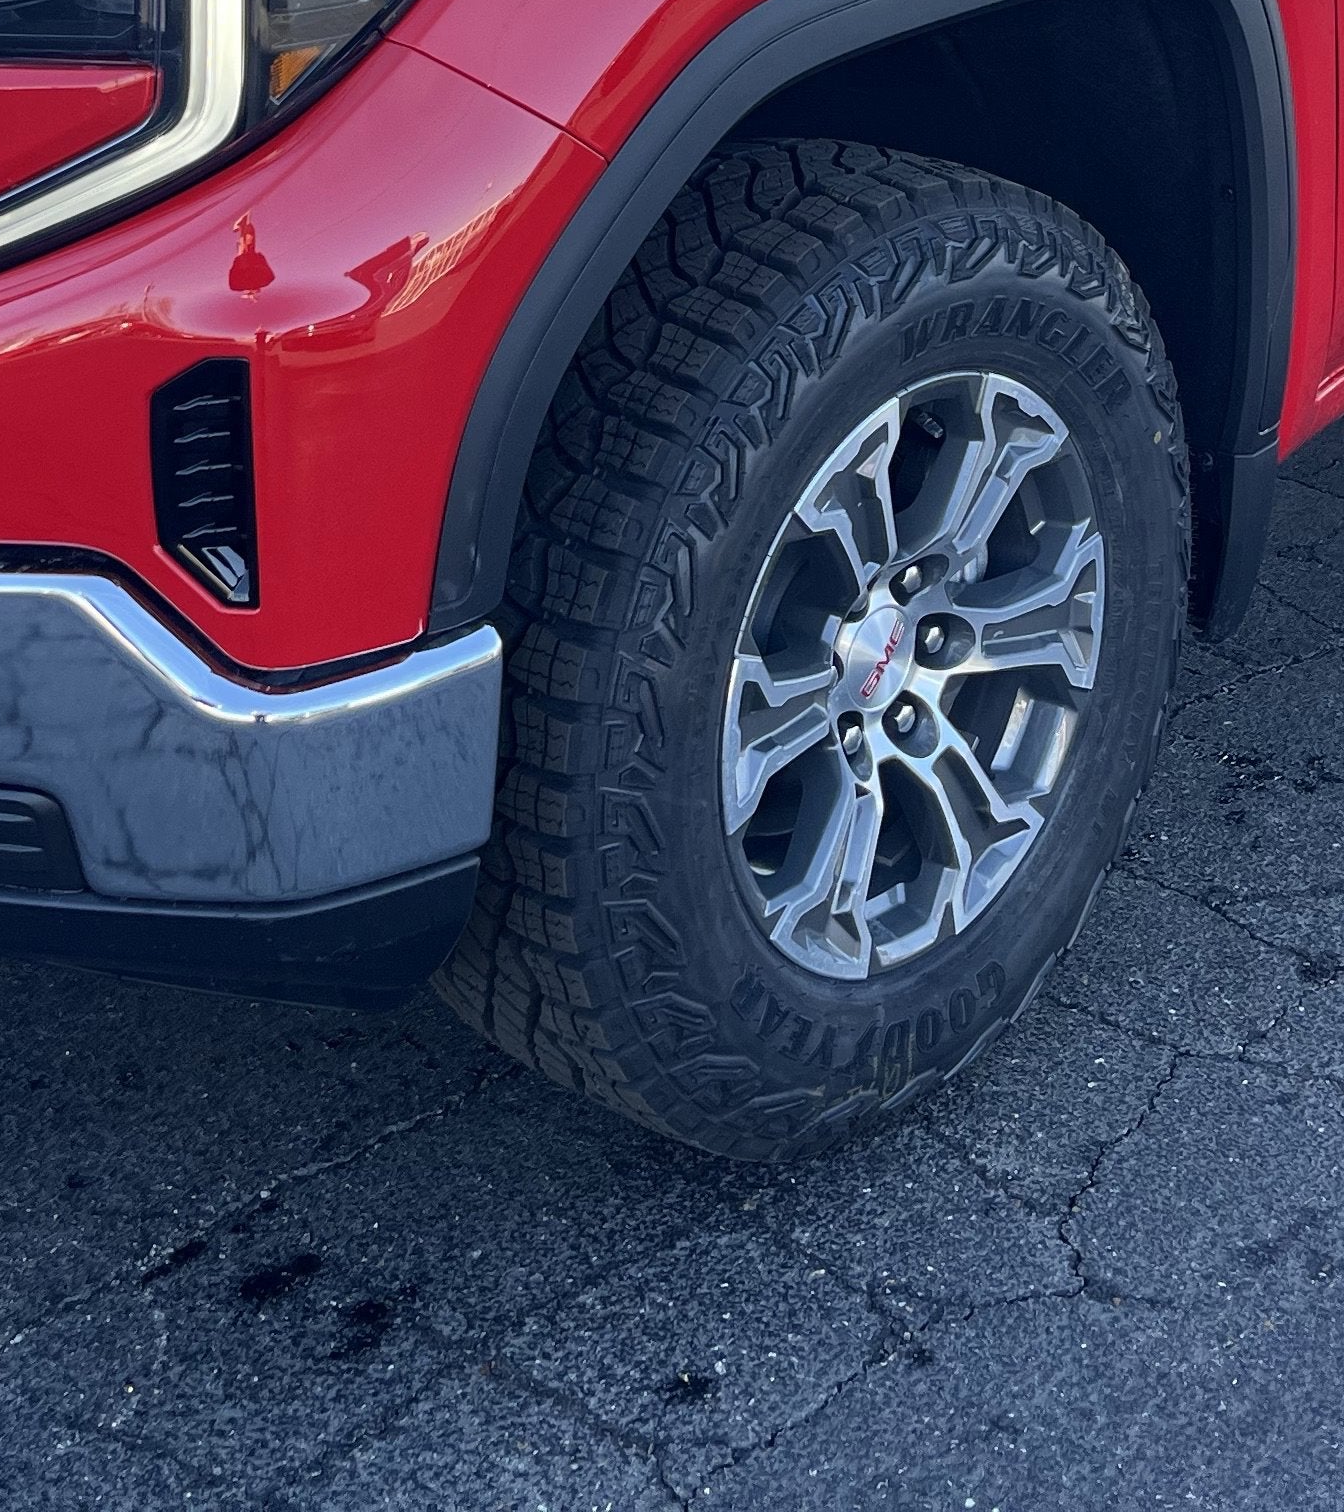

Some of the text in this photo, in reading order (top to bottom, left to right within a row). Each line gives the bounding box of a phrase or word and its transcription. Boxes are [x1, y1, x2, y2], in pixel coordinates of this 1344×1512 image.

[899, 294, 1132, 416] WRANGLER
[860, 618, 905, 699] GMC
[728, 960, 1007, 1070] GOODYEAR
